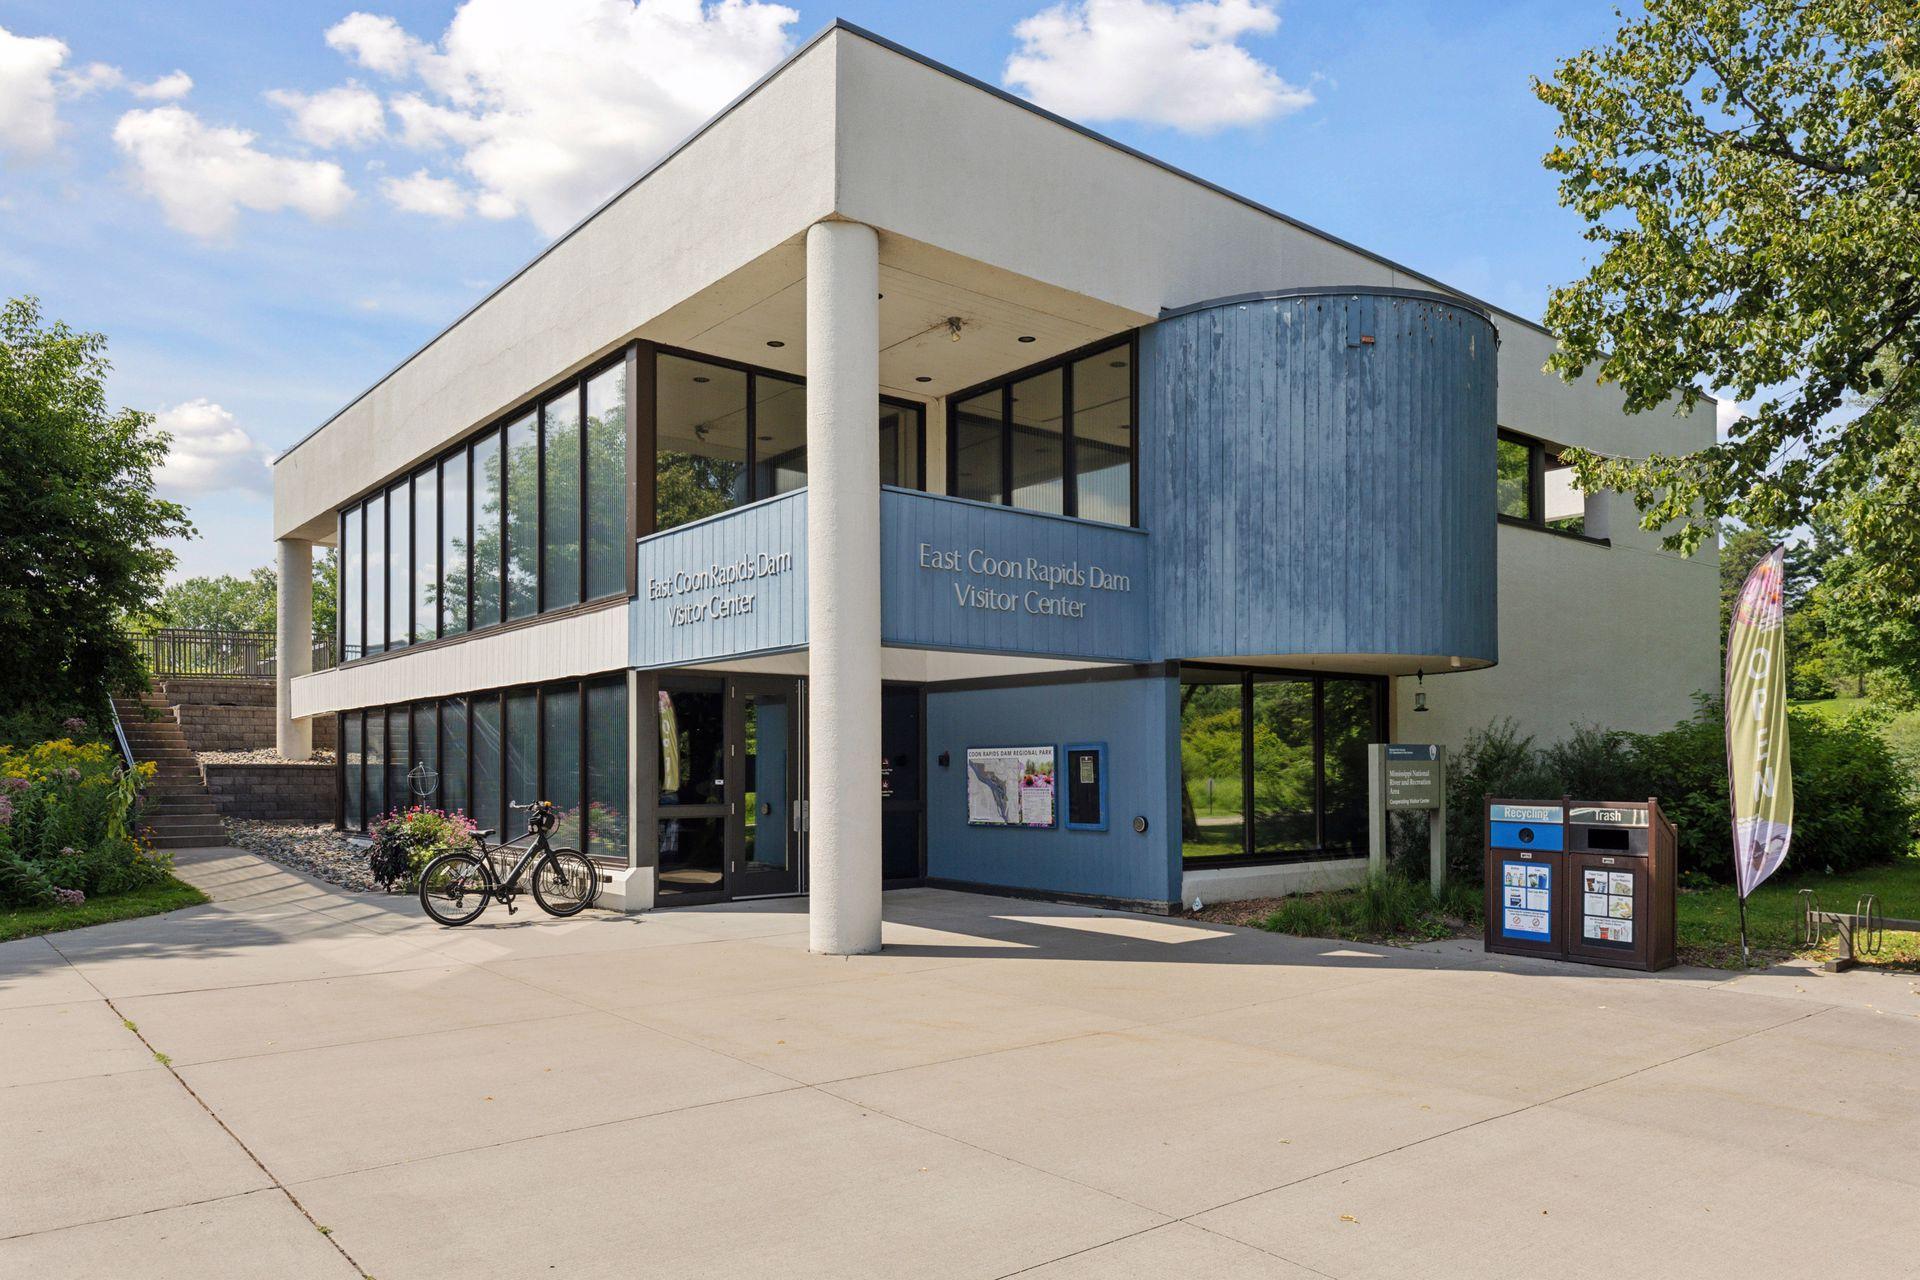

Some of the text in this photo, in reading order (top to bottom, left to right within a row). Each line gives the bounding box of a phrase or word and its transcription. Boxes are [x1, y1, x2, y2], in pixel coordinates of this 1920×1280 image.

[648, 551, 793, 600] East Coon Rapids Dam
[920, 543, 1131, 592] East Coon Rapids Dam
[668, 592, 756, 627] Visitor Center
[954, 582, 1086, 618] Visitor Center
[1504, 807, 1549, 821] Recycling
[1595, 810, 1622, 822] Trash
